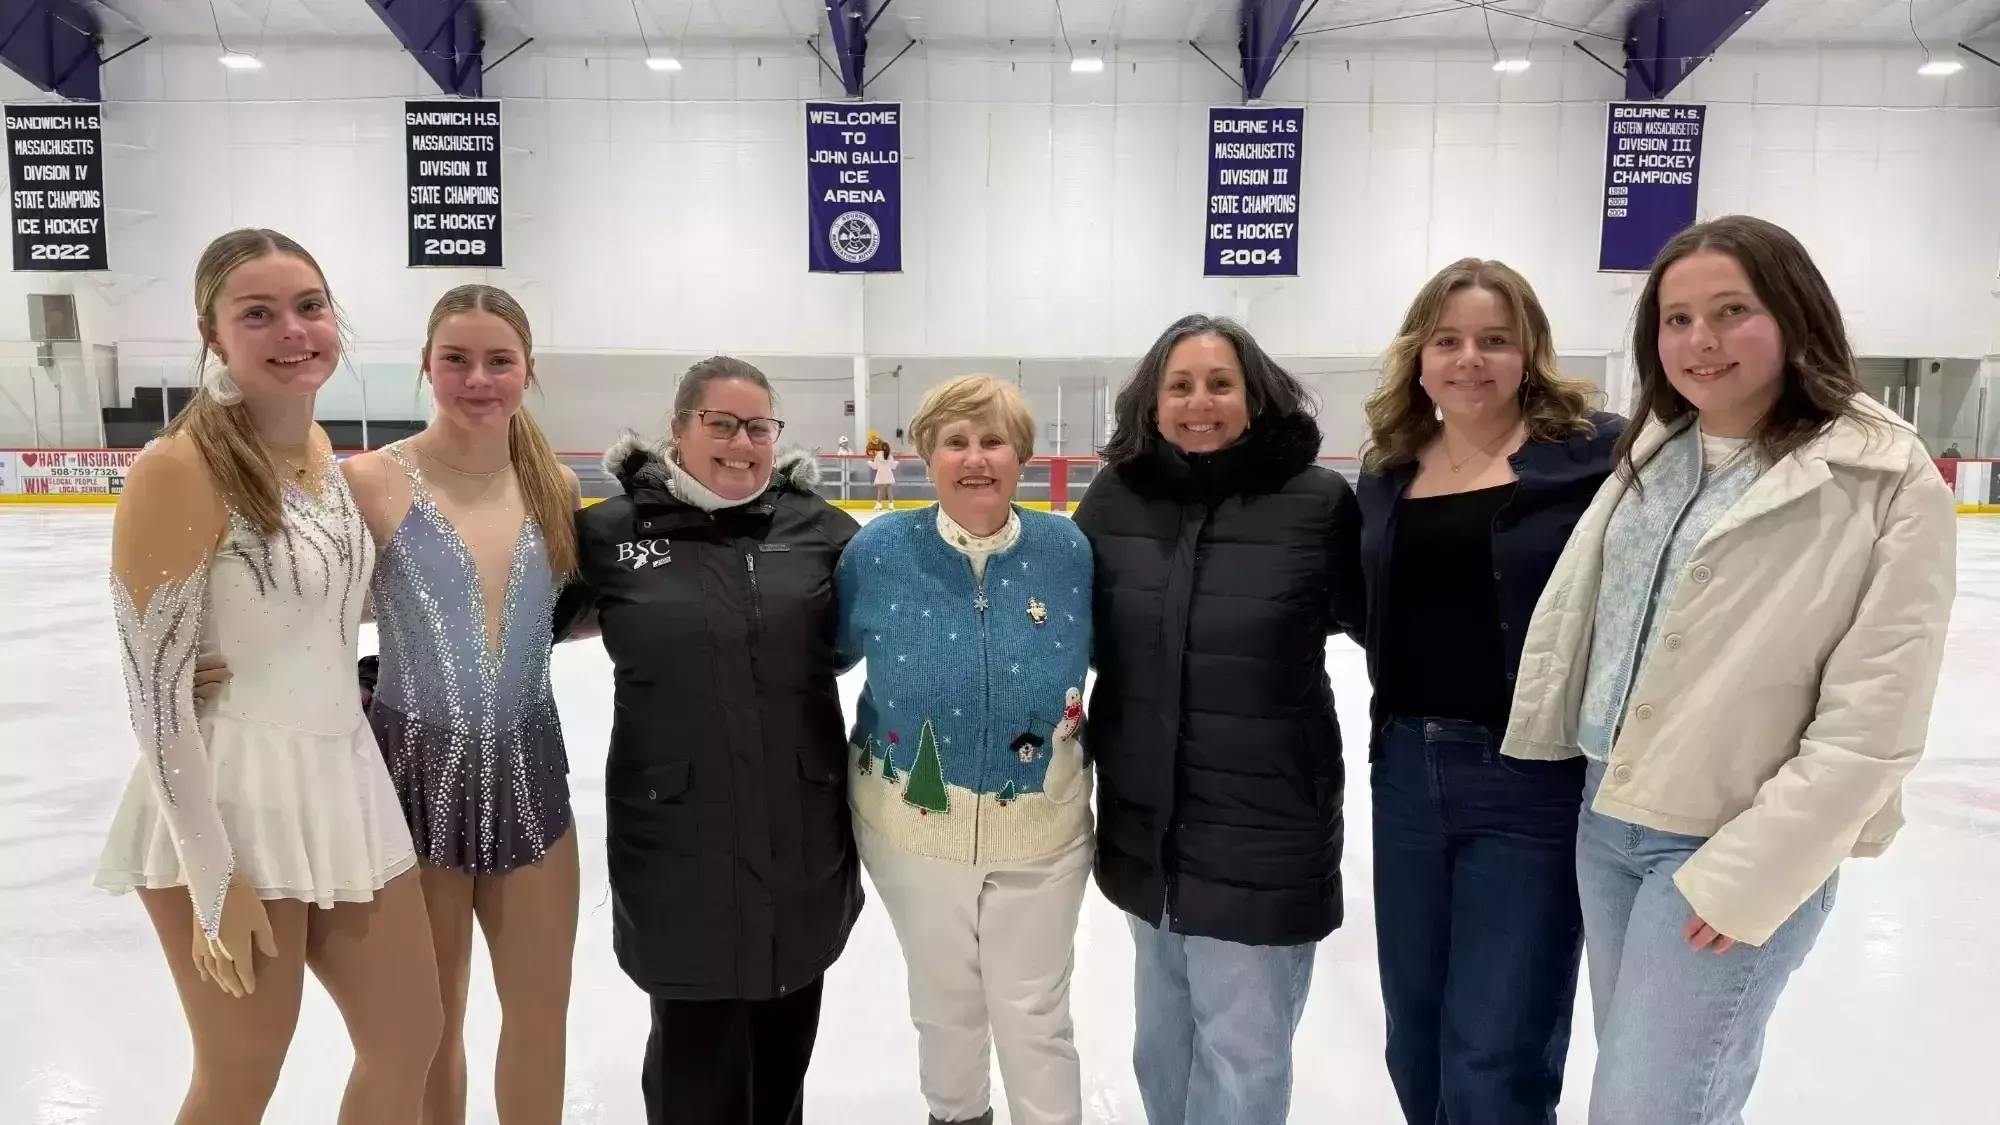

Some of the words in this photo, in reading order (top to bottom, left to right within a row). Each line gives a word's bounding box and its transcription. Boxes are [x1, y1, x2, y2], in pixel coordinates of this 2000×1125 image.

[406, 112, 470, 126] SANDWICH
[475, 112, 499, 126] H.S.
[810, 112, 896, 124] WELCOME
[1614, 108, 1670, 118] BOURNE
[1674, 109, 1700, 119] H.S.
[6, 116, 71, 129] SANDWICH
[75, 116, 100, 130] H.S.
[1214, 120, 1268, 133] BOURNE
[1272, 120, 1298, 133] H.S.
[1613, 122, 1642, 134] EASTERN
[1645, 122, 1699, 135] MASSACHUSETTS
[412, 136, 494, 151] MASSACHUSETTS
[841, 132, 866, 144] TO
[1618, 138, 1667, 151] DIVISION
[1672, 138, 1692, 152] III
[15, 140, 94, 155] MASSACHUSETTS
[1215, 143, 1295, 159] MASSACHUSETTS
[810, 150, 848, 164] JOHN
[852, 151, 898, 164] GALLO
[1613, 154, 1635, 167] ICE
[1638, 155, 1696, 168] HOCKEY
[24, 165, 70, 180] DIVISION
[75, 165, 88, 180] IV
[420, 161, 470, 176] DIVISION
[476, 161, 488, 176] II
[840, 170, 869, 184] ICE
[1220, 170, 1268, 185] DIVISION
[1272, 168, 1288, 184] III
[1613, 171, 1692, 184] CHAMPIONS
[14, 190, 44, 209] STATE
[48, 190, 100, 209] CHAMPIONS
[410, 186, 440, 204] STATE
[444, 186, 499, 204] CHAMPIONS
[824, 190, 885, 202] ARENA
[1211, 196, 1240, 214] STATE
[1242, 195, 1296, 213] CHAMPIONS
[18, 218, 40, 234] ICE
[45, 218, 98, 234] HOCKEY
[414, 214, 436, 230] ICE
[440, 214, 496, 230] HOCKEY
[1210, 224, 1232, 239] ICE
[1237, 224, 1294, 240] HOCKEY
[32, 244, 90, 260] 2022
[424, 240, 486, 254] 2008
[1220, 249, 1282, 264] 2004
[39, 453, 66, 467] HART
[24, 478, 48, 494] WIN
[616, 538, 670, 562] BSC
